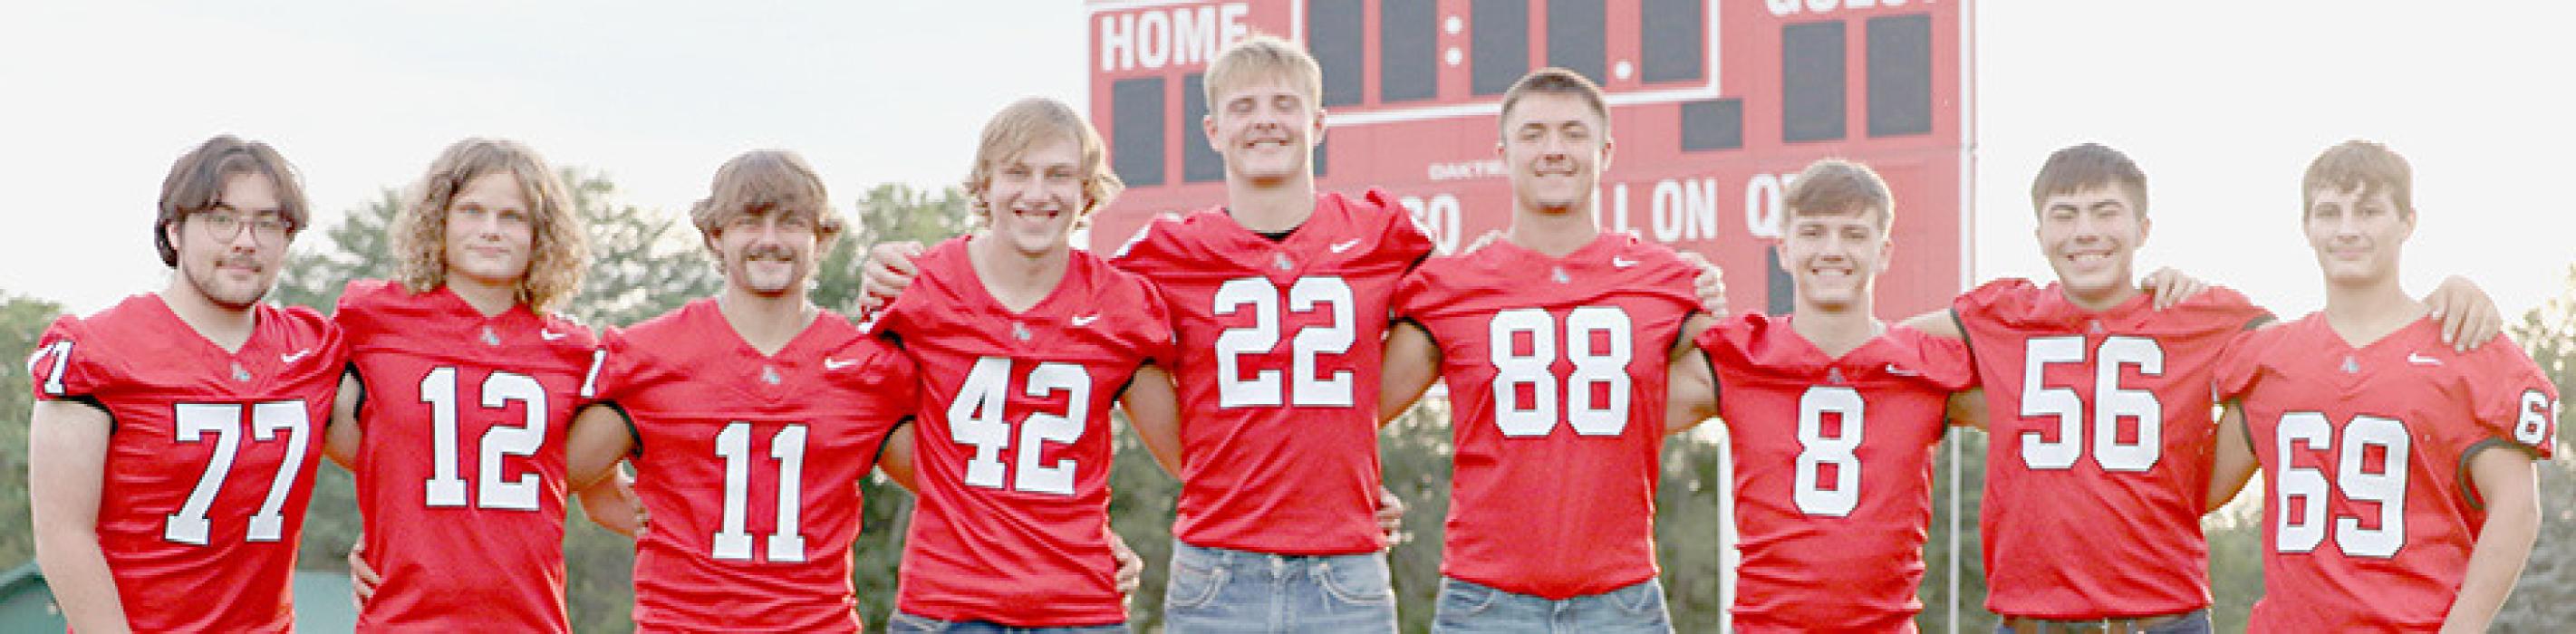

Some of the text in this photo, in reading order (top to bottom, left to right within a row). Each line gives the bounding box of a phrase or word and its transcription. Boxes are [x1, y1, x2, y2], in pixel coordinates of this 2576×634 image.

[1101, 5, 1249, 72] HOME
[1653, 178, 1717, 242] ON
[1213, 276, 1356, 408] 22
[1489, 305, 1633, 437] 88
[2020, 335, 2163, 473] 56
[164, 399, 310, 545] 77
[420, 366, 547, 512] 12
[947, 357, 1091, 495] 42
[1794, 385, 1865, 518] 8
[2275, 410, 2411, 560] 69
[2514, 389, 2559, 447] 6
[711, 421, 808, 562] 11
